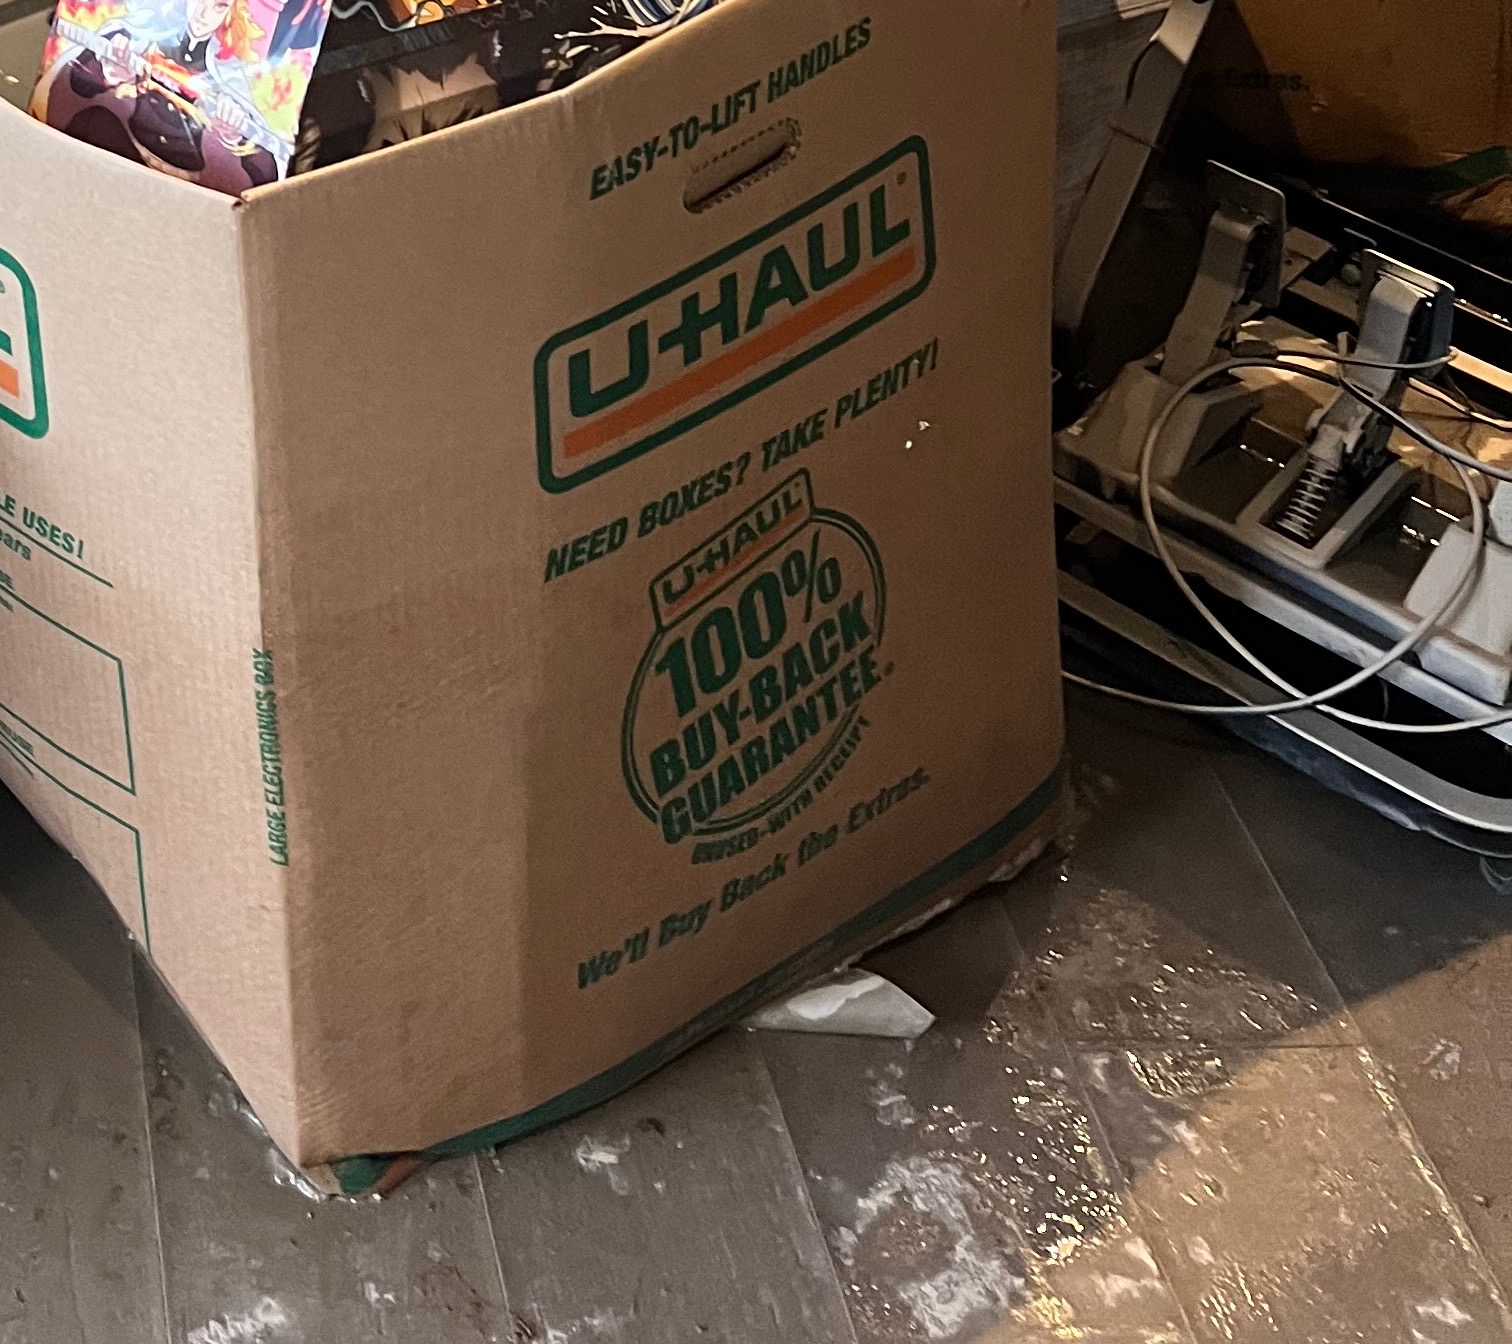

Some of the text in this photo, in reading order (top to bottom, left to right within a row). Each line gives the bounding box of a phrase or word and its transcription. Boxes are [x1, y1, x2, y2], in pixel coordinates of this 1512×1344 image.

[589, 16, 873, 201] EASY-TO-LIFT HANDLES
[567, 181, 912, 419] U-HAUL
[22, 506, 86, 561] USES!
[544, 336, 939, 585] NEED BOXES? TAKE PLENTY!
[648, 590, 873, 799] BUY-BACK
[652, 531, 844, 716] 100%
[252, 647, 290, 867] LARGE ELECTRONICS BOX
[578, 925, 650, 990] We'll
[657, 900, 714, 948] Buy
[719, 851, 789, 912] Back
